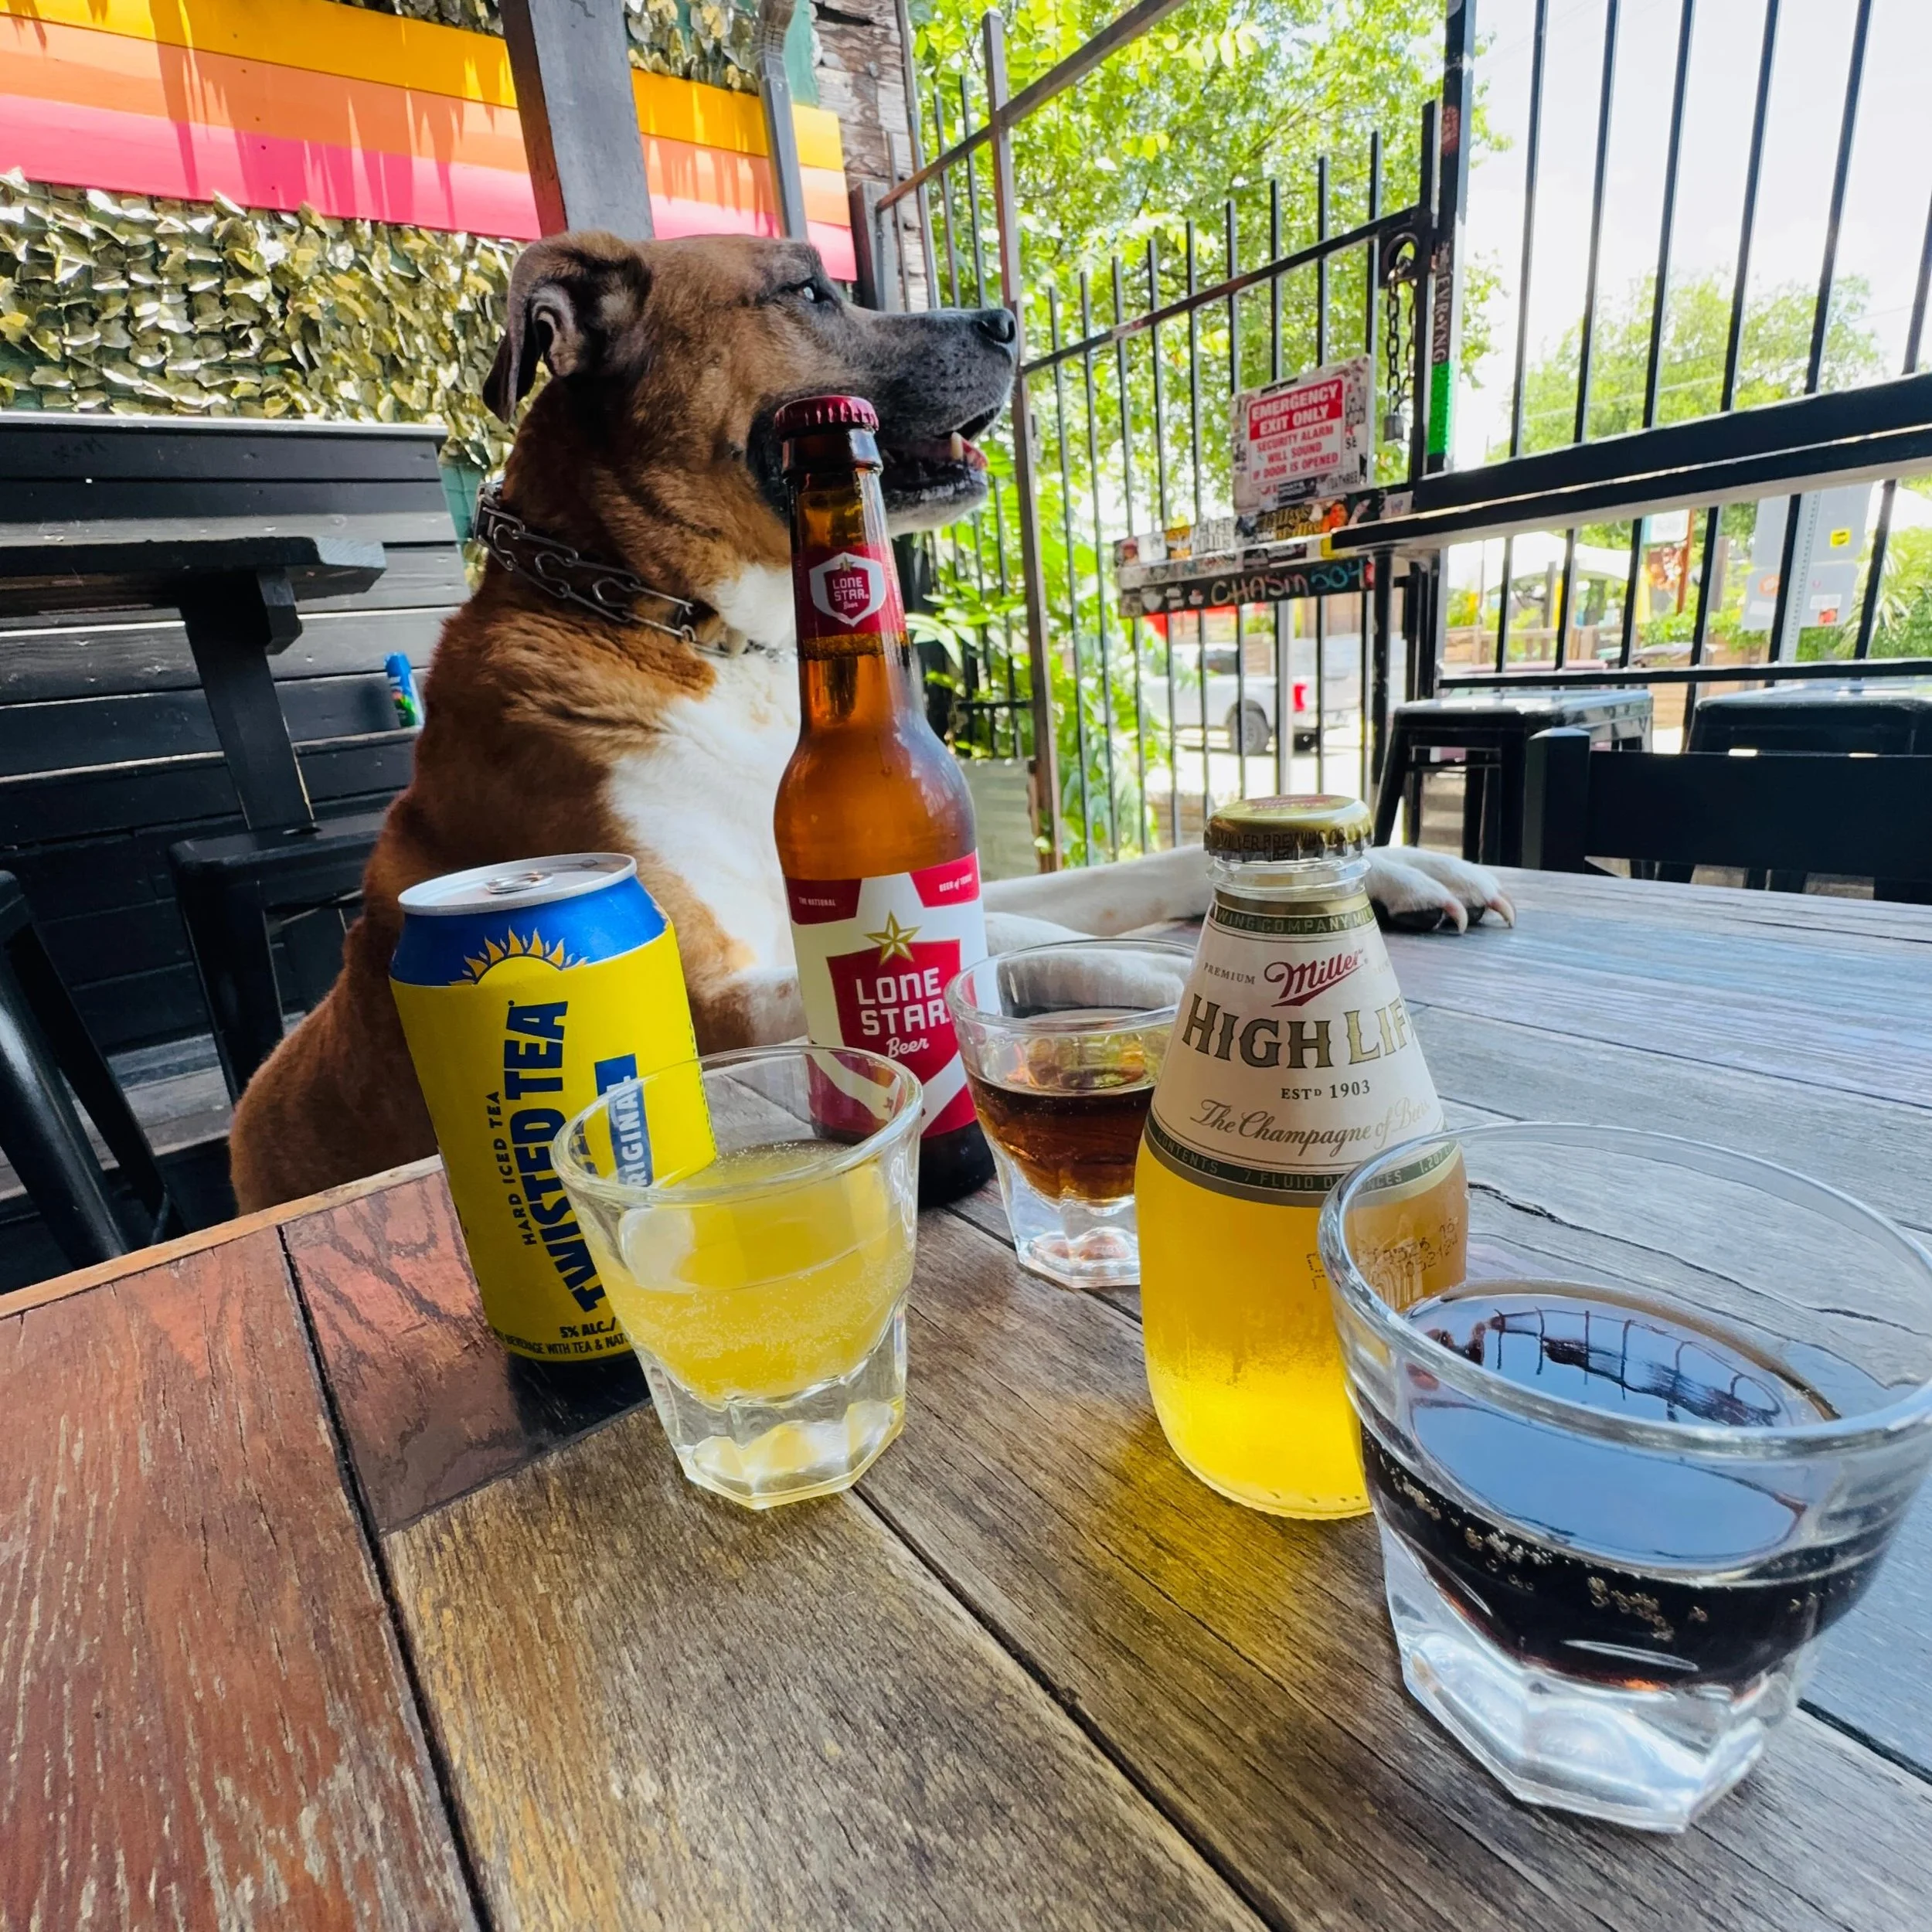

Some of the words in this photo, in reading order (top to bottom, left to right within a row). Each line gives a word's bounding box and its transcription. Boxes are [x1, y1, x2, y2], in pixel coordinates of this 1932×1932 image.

[1252, 383, 1338, 420] EMERGENCY
[1260, 415, 1289, 435] EXIT
[1293, 403, 1328, 427] ONLY
[1257, 434, 1297, 453] SECURITY
[1301, 425, 1333, 440] ALARM
[1268, 450, 1287, 463] WILL
[1291, 442, 1322, 457] SOUND
[1264, 464, 1287, 478] DOOR
[1290, 462, 1298, 471] IS
[1302, 452, 1338, 470] OPENED
[832, 577, 863, 589] LONE
[834, 588, 866, 601] STAR
[1261, 914, 1349, 933] COMPANY
[855, 967, 942, 1005] LONE
[1203, 961, 1256, 985] PREMIUM
[1264, 948, 1363, 1007] Miller
[860, 998, 947, 1036] STAR
[1182, 993, 1334, 1069] HIGH
[1344, 997, 1413, 1066] LIF
[504, 1001, 568, 1100] TEA
[886, 1036, 930, 1058] Beer
[1329, 1079, 1371, 1099] 1903
[485, 1091, 503, 1129] TEA
[1190, 1099, 1235, 1134] The
[1238, 1110, 1371, 1158] Champagne
[1373, 1105, 1393, 1151] of
[606, 1075, 648, 1188] RIGINAL
[493, 1138, 516, 1184] ICED
[1160, 1131, 1219, 1175] CONTENTS
[1243, 1169, 1253, 1182] 7
[1260, 1172, 1315, 1190] FLUID
[1322, 1169, 1403, 1192] ONCES
[508, 1193, 538, 1246] HARD
[509, 1108, 606, 1312] TWISTED
[545, 1342, 571, 1355] WITH
[572, 1340, 593, 1353] TEA
[594, 1338, 604, 1351] &
[604, 1333, 628, 1348] NAT
[560, 1325, 580, 1338] 5%
